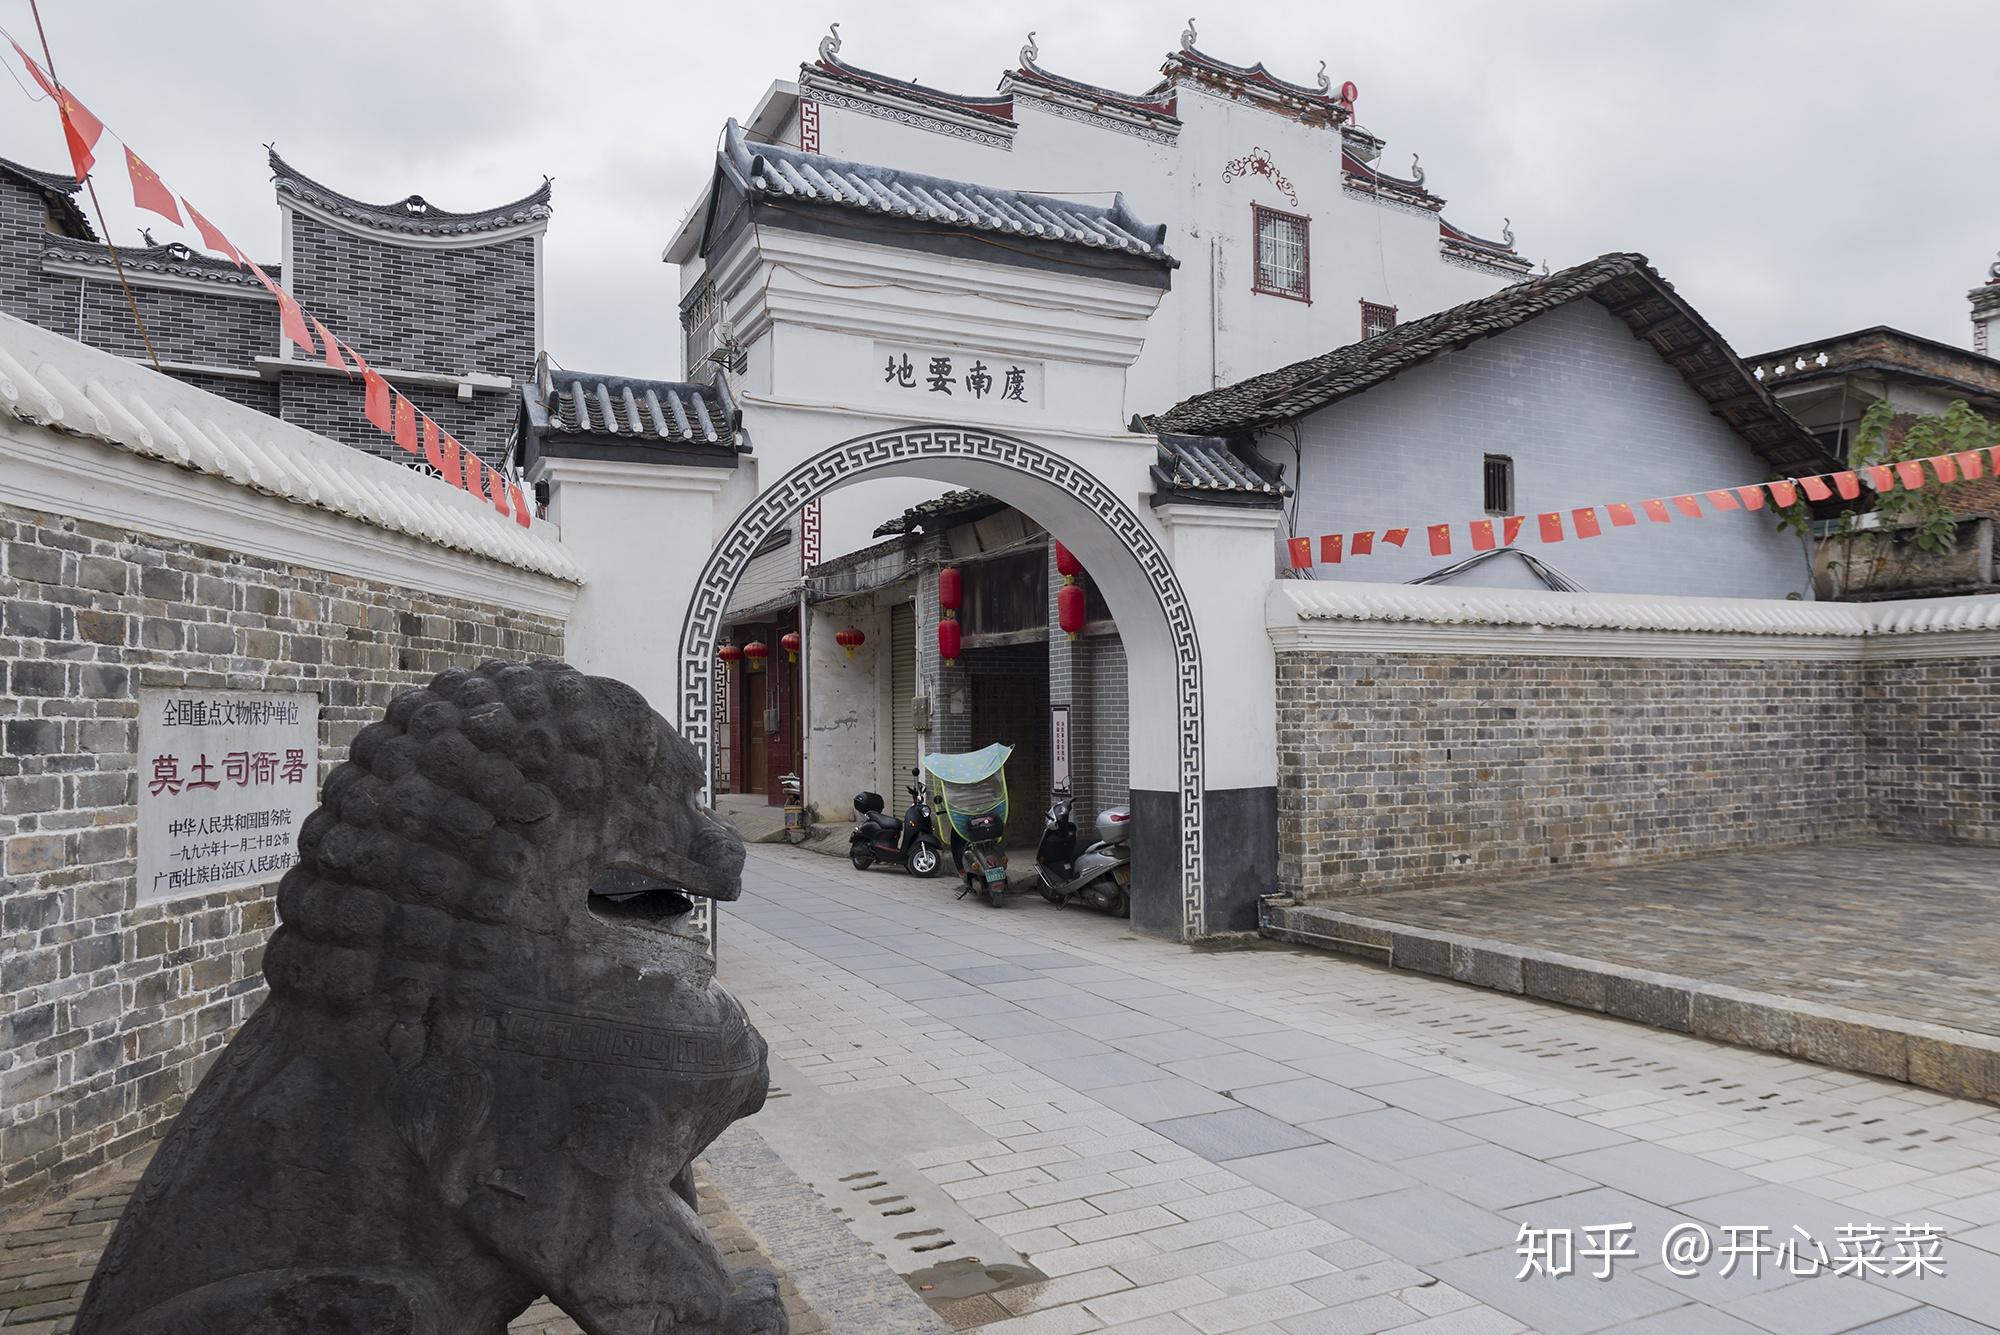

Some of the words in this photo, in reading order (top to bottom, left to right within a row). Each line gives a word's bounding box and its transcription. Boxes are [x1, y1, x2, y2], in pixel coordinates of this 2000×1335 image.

[162, 699, 299, 727] 全国重点文物保护单位
[148, 748, 309, 797] 莫土司衙署
[168, 808, 292, 838] 中华人民共和国国务院
[170, 831, 290, 862] 一九九六年十一月二十日公布
